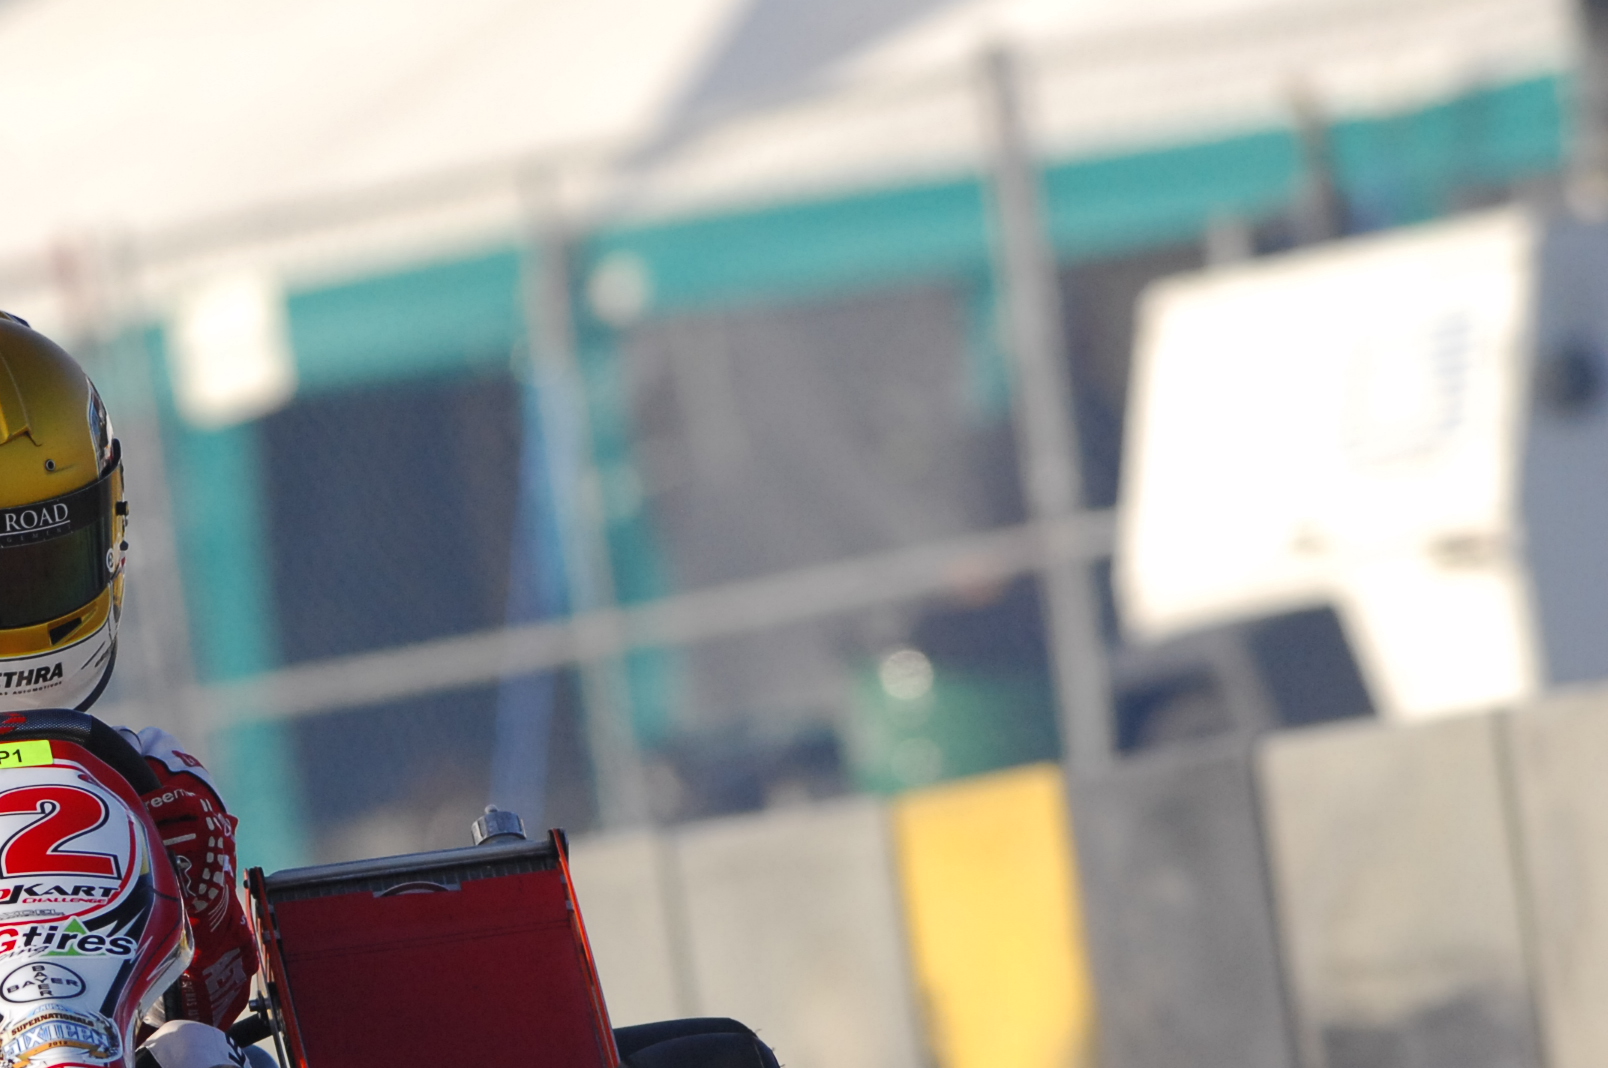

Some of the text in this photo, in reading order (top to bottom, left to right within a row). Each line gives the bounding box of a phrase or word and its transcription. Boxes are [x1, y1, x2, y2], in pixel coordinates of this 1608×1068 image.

[5, 503, 69, 532] ROAD
[6, 978, 80, 992] BAYER
[32, 965, 53, 997] BAYER
